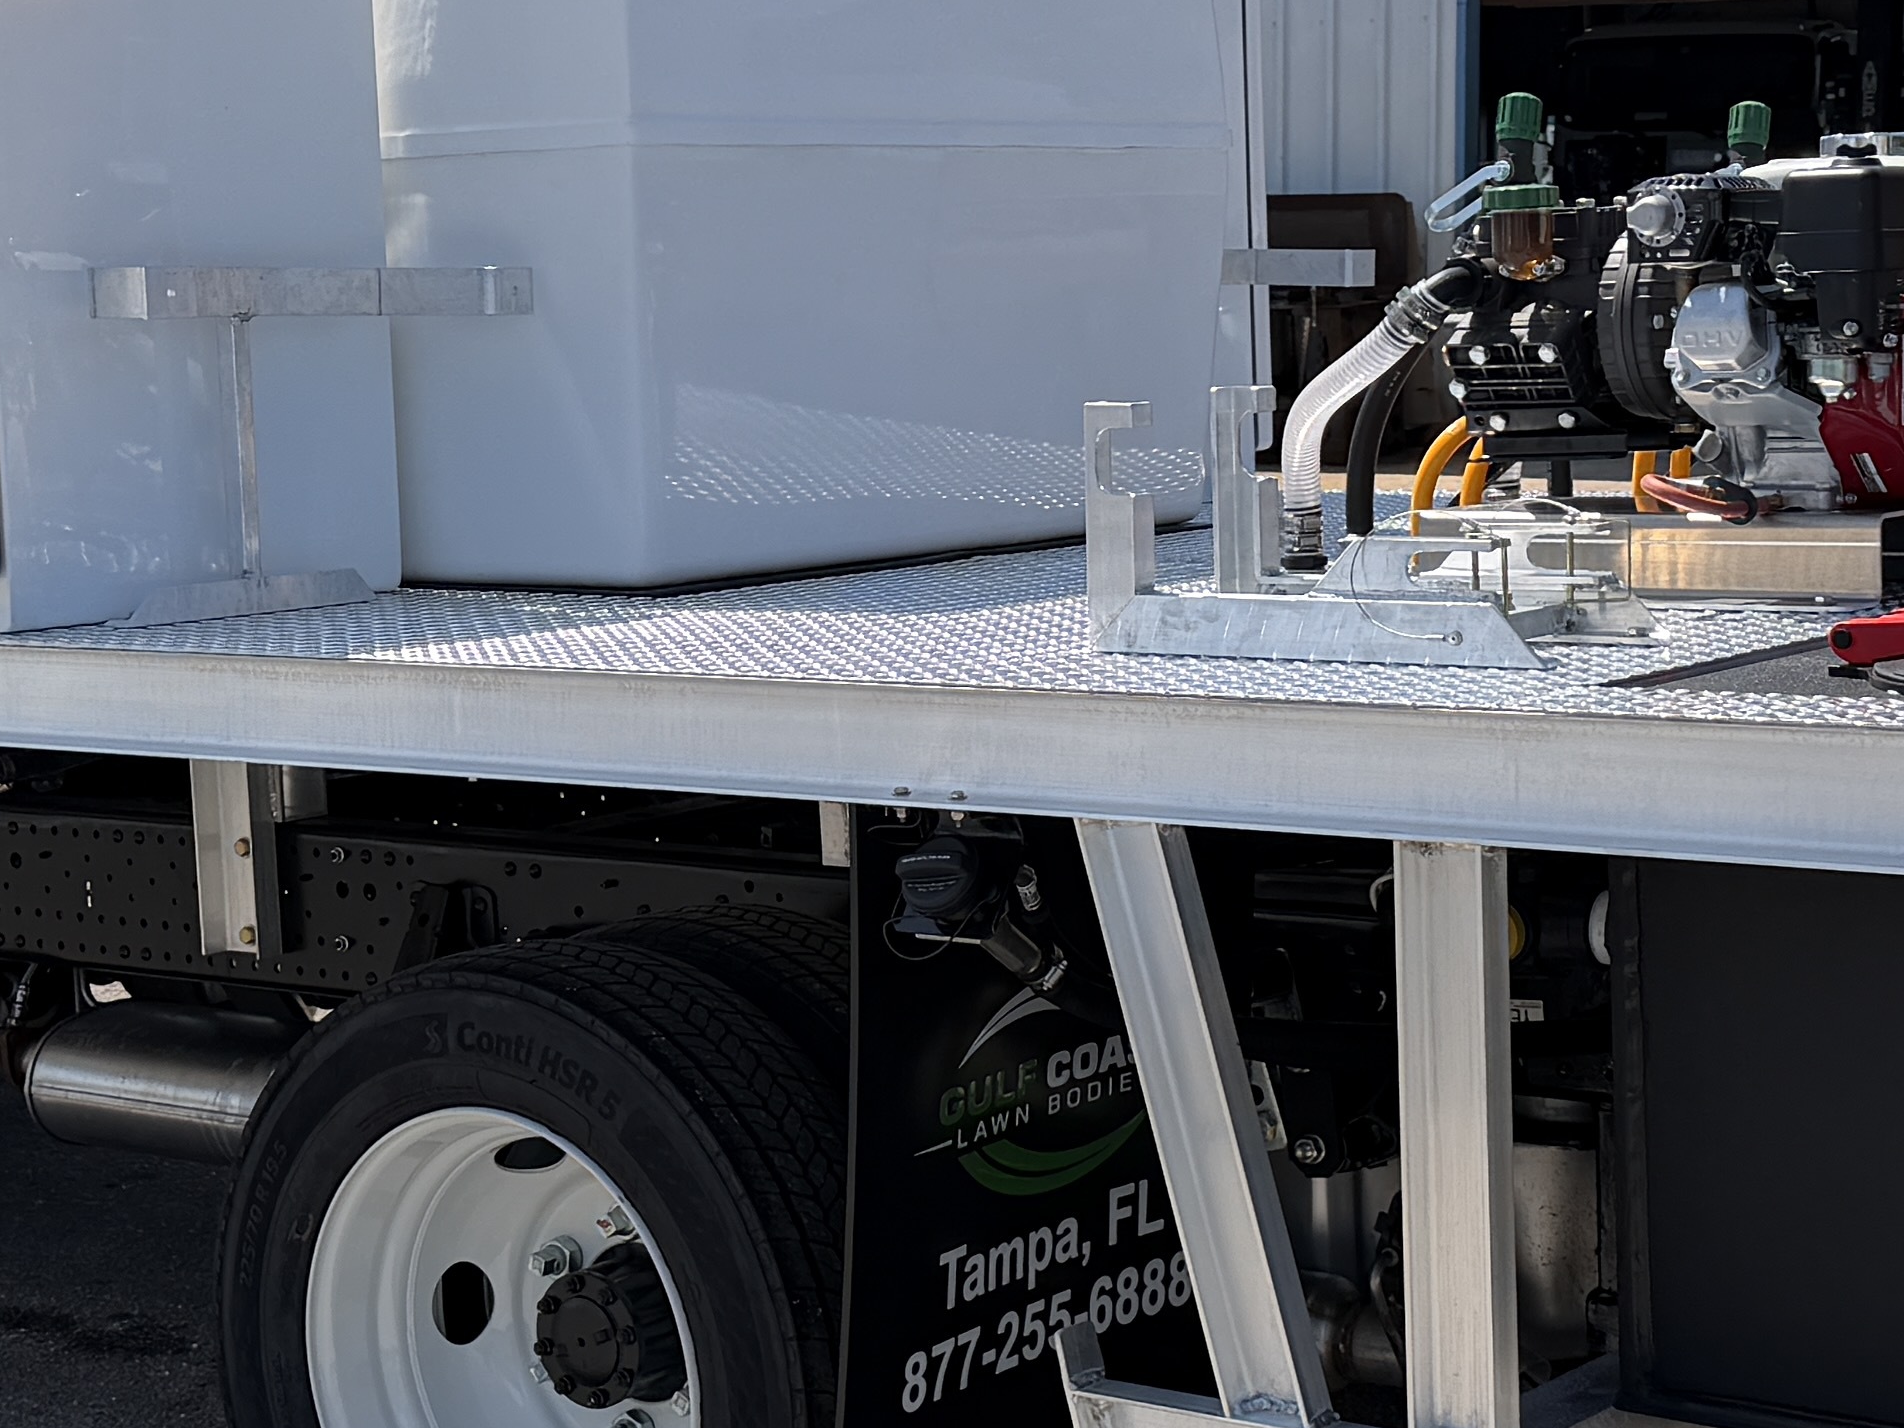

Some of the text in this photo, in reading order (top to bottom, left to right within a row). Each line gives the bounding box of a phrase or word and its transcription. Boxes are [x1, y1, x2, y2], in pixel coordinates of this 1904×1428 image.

[456, 1021, 622, 1121] Conti HSR 5
[939, 1034, 1136, 1127] GULF COA
[956, 1071, 1133, 1150] LAWN BODIE
[239, 1139, 289, 1286] 225/70 R 19.5
[939, 1179, 1165, 1311] Tampa, FL
[901, 1250, 1193, 1414] 877-255-6888
